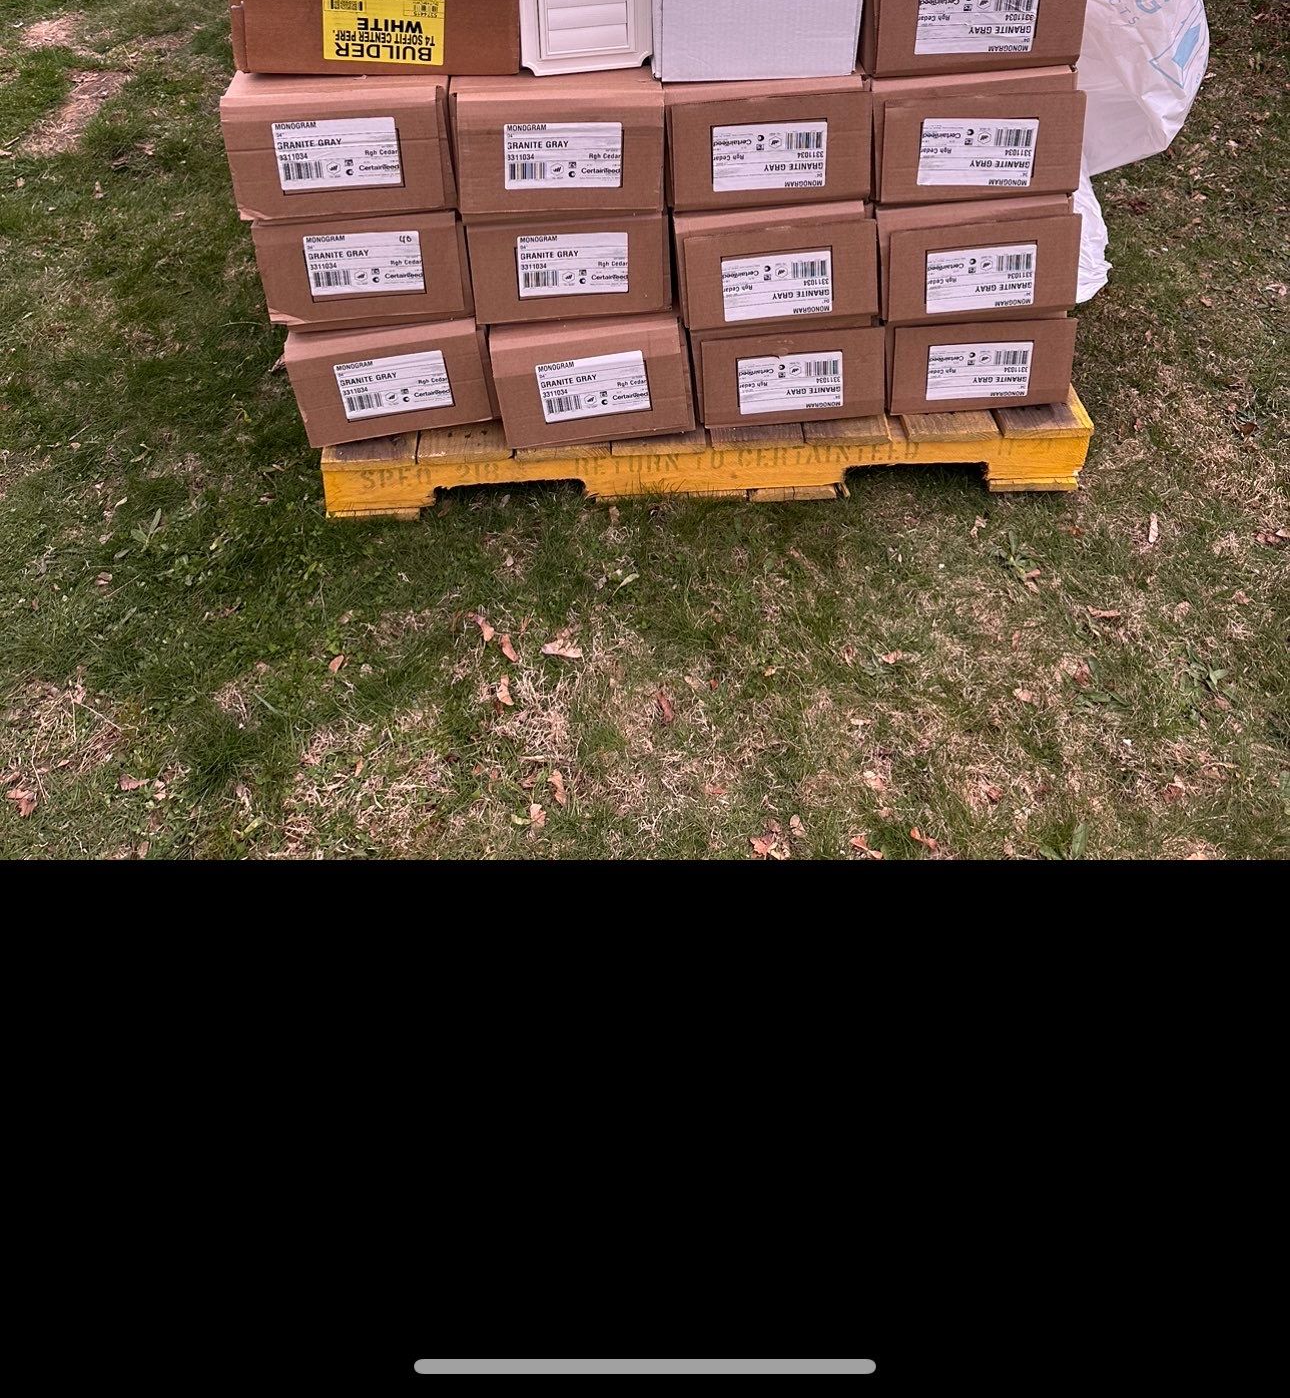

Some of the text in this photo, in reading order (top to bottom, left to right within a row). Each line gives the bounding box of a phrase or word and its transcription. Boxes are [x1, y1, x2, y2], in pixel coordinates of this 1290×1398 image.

[356, 17, 423, 34] WHITE
[995, 26, 1032, 34] GRANITE
[332, 30, 436, 47] T4 SOFFIT CENTER PERF.
[334, 42, 433, 62] BUILDER
[275, 122, 317, 130] MONOGRAM
[507, 124, 547, 132] MONOGRAM
[277, 138, 342, 150] GRANITE GRAY
[507, 140, 569, 150] GRANITE GRAY
[279, 153, 308, 161] 3311034
[507, 153, 535, 161] 3311034
[1004, 149, 1032, 157] 3311034
[763, 162, 824, 171] GRANITE GRAY
[969, 160, 1031, 169] GRANITE GRAY
[306, 235, 345, 243] MONOGRAM
[520, 235, 558, 243] MONOGRAM
[308, 249, 370, 260] GRANITE GRAY
[520, 250, 579, 261] GRANITE GRAY
[310, 262, 337, 271] 3311034
[521, 263, 547, 271] 3311034
[1007, 271, 1033, 279] 3311034
[803, 278, 829, 286] 3311034
[974, 282, 1033, 293] GRANITE GRAY
[772, 289, 830, 300] GRANITE GRAY
[994, 299, 1032, 307] MONOGRAM
[792, 305, 830, 314] MONOGRAM
[336, 361, 374, 371] MONOGRAM
[538, 361, 575, 373] MONOGRAM
[340, 372, 397, 387] GRANITE GRAY
[541, 374, 598, 389] GRANITE GRAY
[816, 376, 841, 384] 3311034
[972, 376, 994, 384] GRAY
[342, 386, 369, 396] 3311034
[543, 389, 568, 399] 3311034
[785, 386, 841, 396] GRANITE GRAY
[574, 453, 679, 476] RETURN
